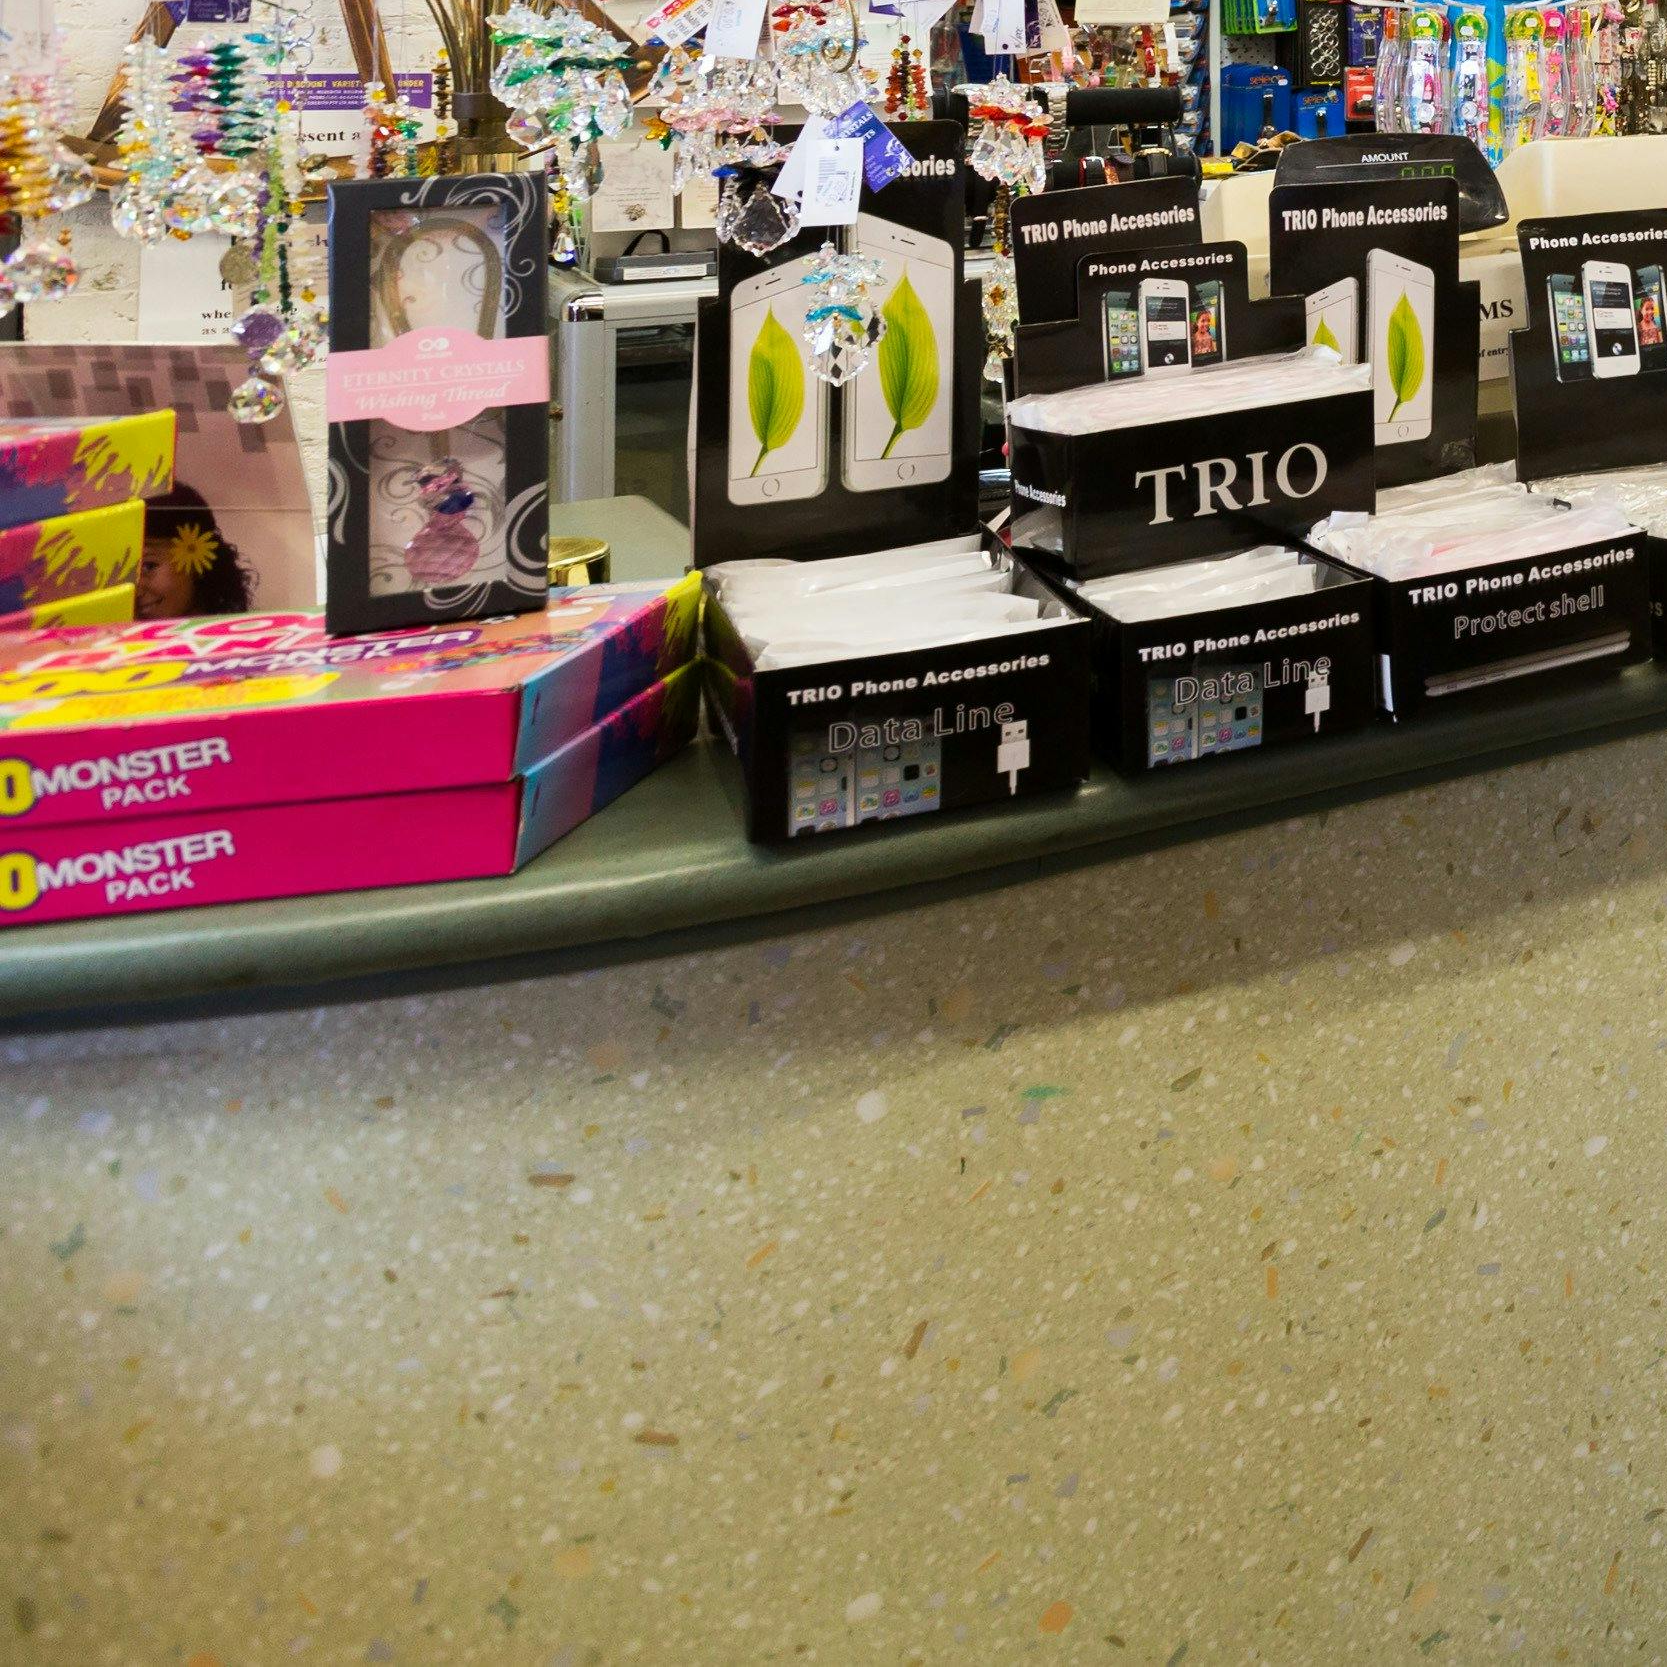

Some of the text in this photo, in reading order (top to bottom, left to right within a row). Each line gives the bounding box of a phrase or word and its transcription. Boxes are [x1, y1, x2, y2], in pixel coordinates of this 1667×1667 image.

[1361, 152, 1409, 163] AMOUNT
[1021, 205, 1195, 245] TRIO Phone Accessories
[1281, 201, 1448, 232] TRIO Phone Accessories
[1529, 233, 1578, 250] Phone
[1088, 252, 1234, 278] Phone Accessories
[343, 359, 526, 388] ETERNITY CRYSTALS
[355, 381, 510, 411] Wishing Thread
[1031, 484, 1066, 509] Accessories
[1136, 442, 1329, 526] TRIO
[1408, 546, 1636, 606] TRIO Phone Accessories
[1454, 584, 1605, 640] Protect shell
[1138, 610, 1360, 662] TRIO Phone Accessories
[787, 651, 1050, 706] TRIO Phone Accessories
[1174, 651, 1332, 707] Data Line
[827, 698, 1015, 753] Data Line
[30, 736, 233, 798] MONSTER
[102, 774, 191, 811] PACK
[37, 829, 236, 890] MONSTER
[105, 866, 195, 904] PACK
